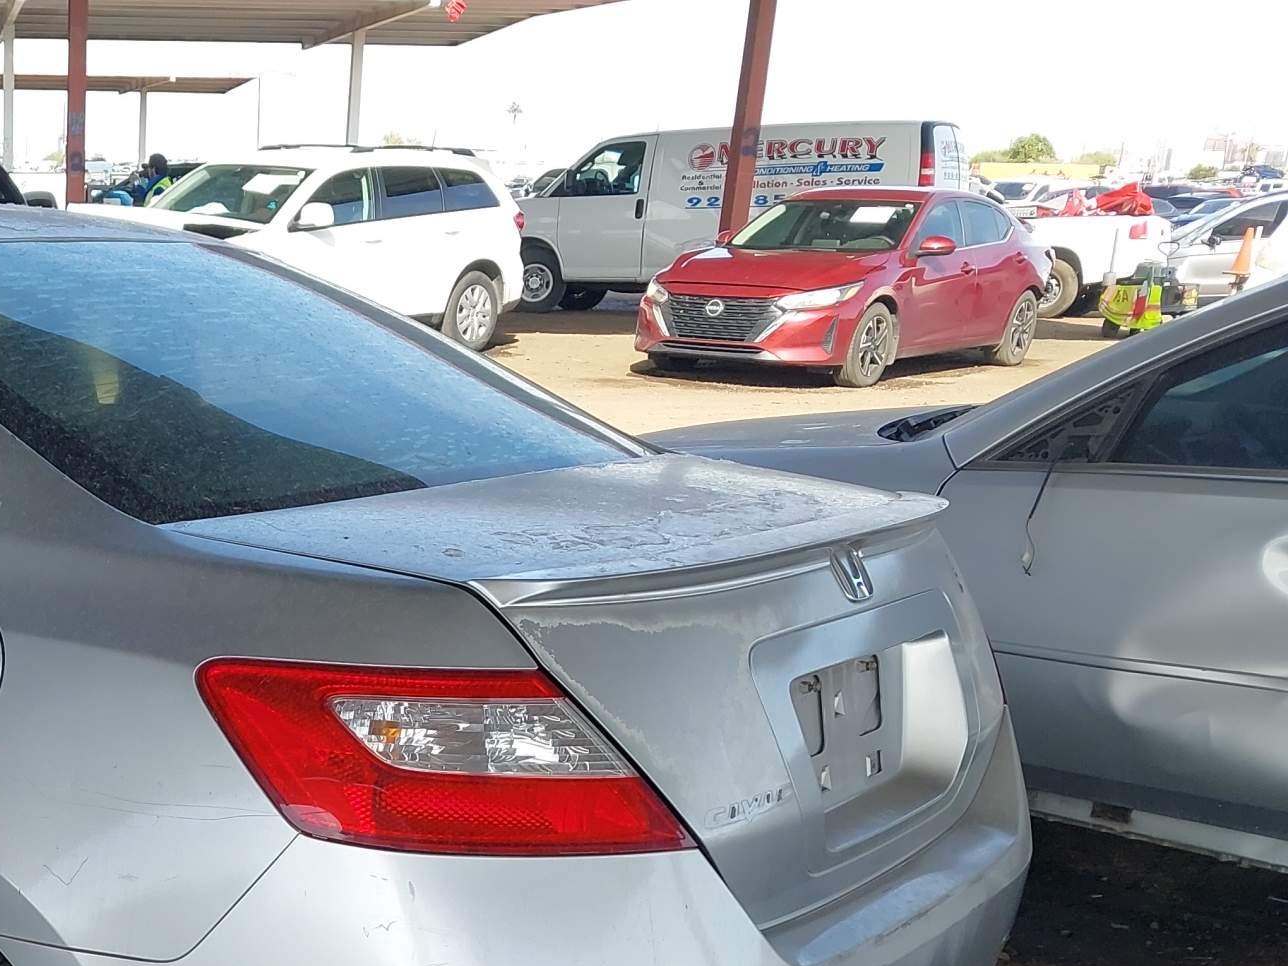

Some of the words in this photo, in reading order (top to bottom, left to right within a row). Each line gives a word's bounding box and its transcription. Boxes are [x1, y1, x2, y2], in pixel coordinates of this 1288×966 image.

[826, 164, 869, 172] HEATING
[796, 177, 827, 187] Sales
[836, 175, 880, 186] Service
